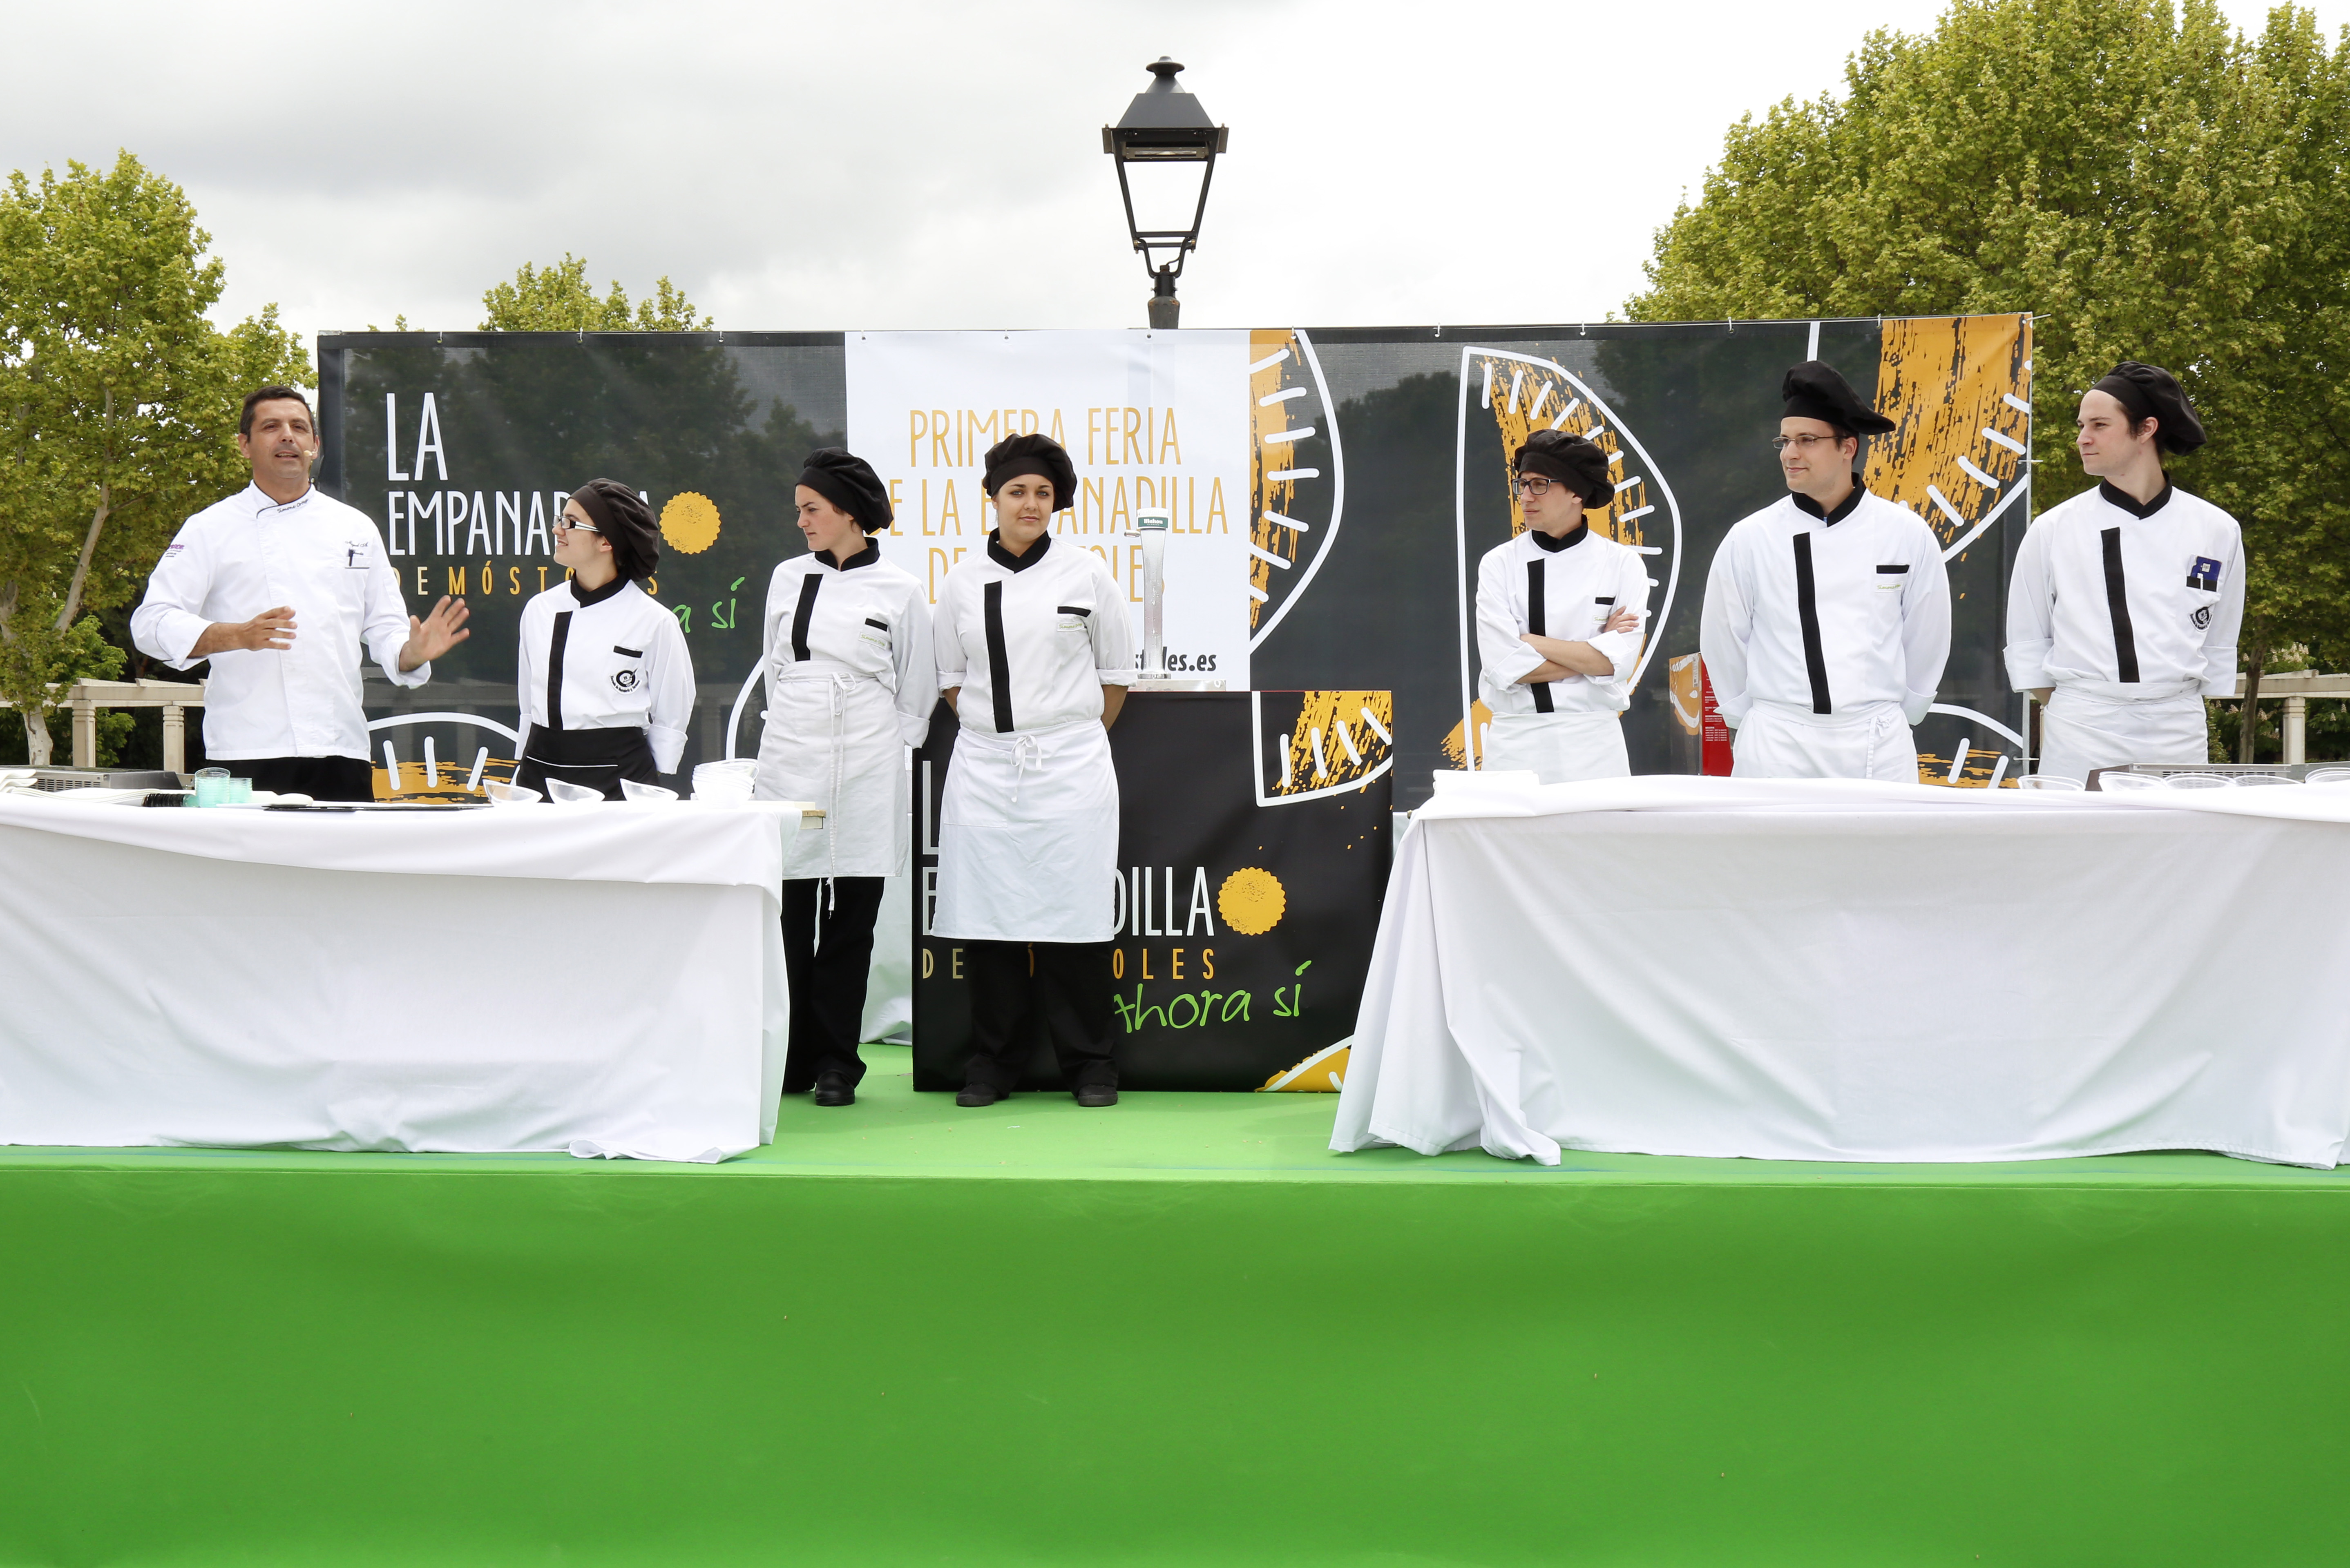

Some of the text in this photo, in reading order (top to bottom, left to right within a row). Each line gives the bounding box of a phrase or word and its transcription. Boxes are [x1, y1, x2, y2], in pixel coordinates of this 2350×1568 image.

[386, 392, 448, 481] LA
[1088, 407, 1182, 465] FERIA
[388, 491, 650, 555] EMPANA
[865, 476, 1229, 536] E LA EANADILLA
[448, 560, 658, 595] MÓSTS
[711, 576, 746, 629] sí
[1135, 646, 1217, 671] tles.es
[923, 948, 963, 979] DE
[1273, 960, 1312, 1017] sí
